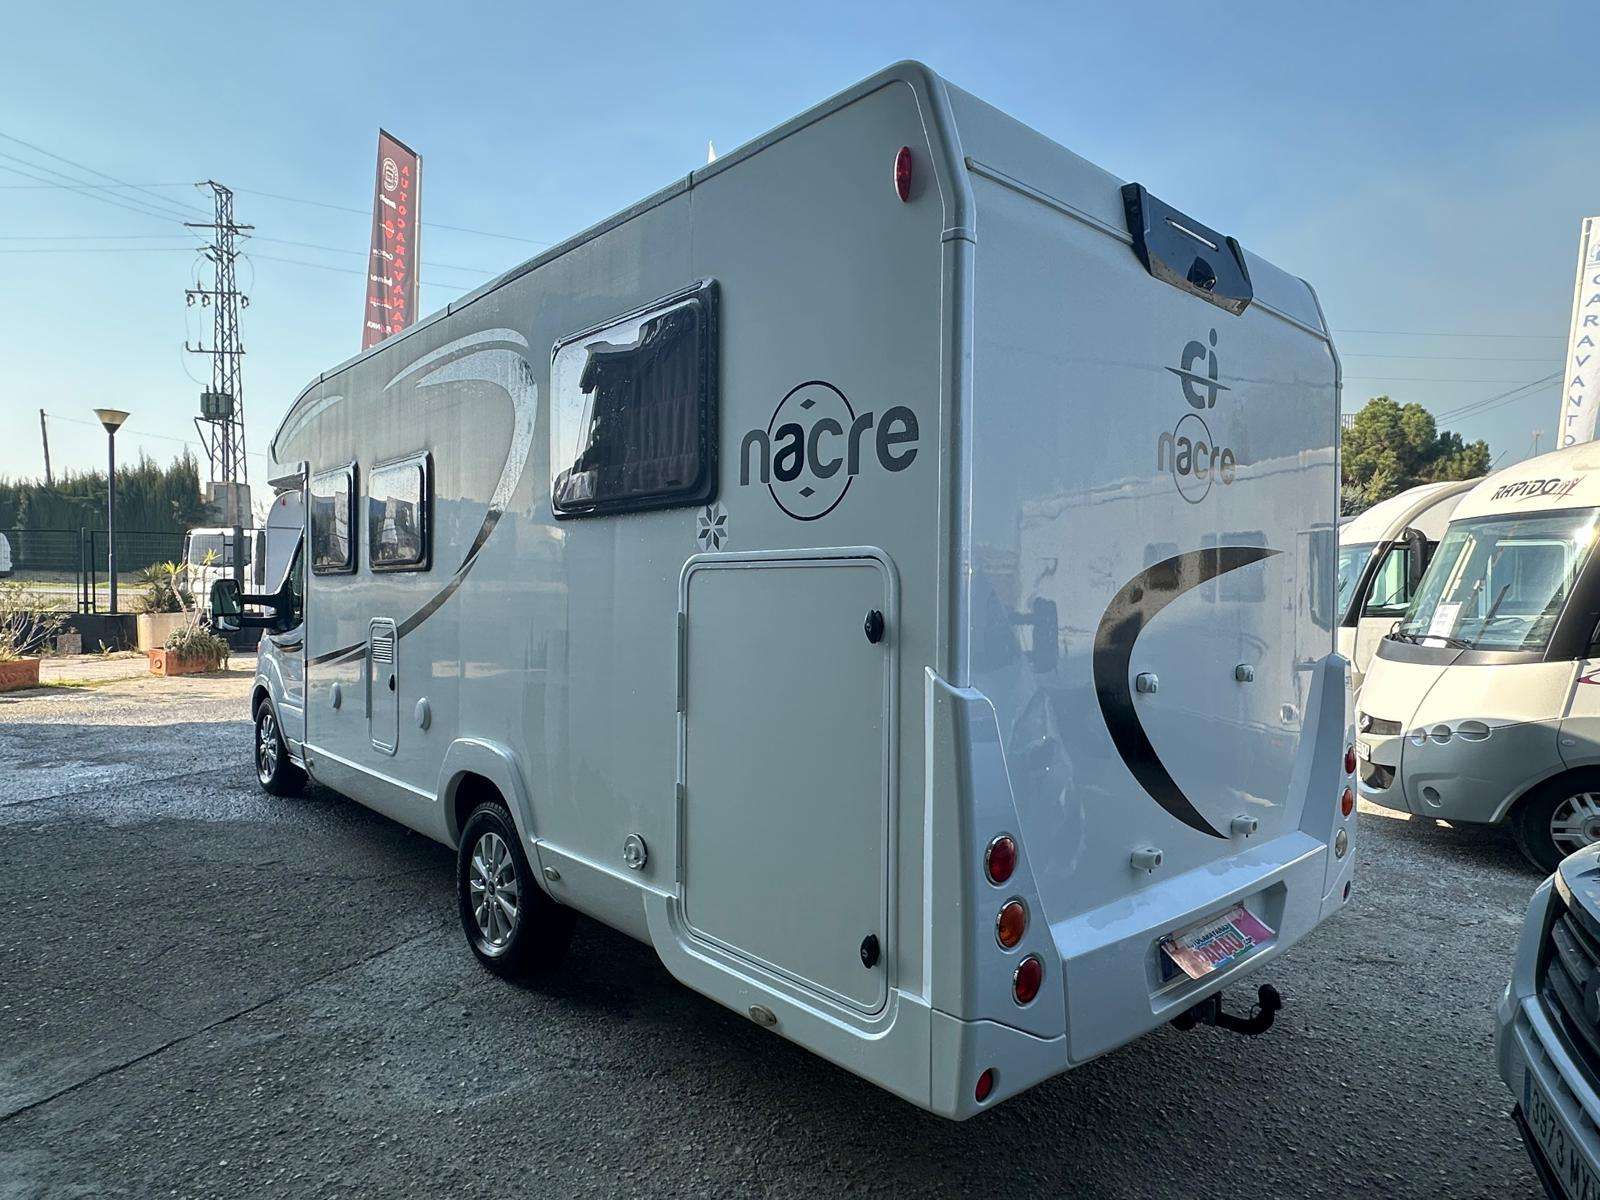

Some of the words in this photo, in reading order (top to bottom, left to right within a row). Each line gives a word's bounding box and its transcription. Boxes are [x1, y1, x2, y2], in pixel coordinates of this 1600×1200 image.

[739, 405, 920, 486] nacre
[1157, 431, 1236, 485] nacre
[1531, 1090, 1565, 1169] 3973
